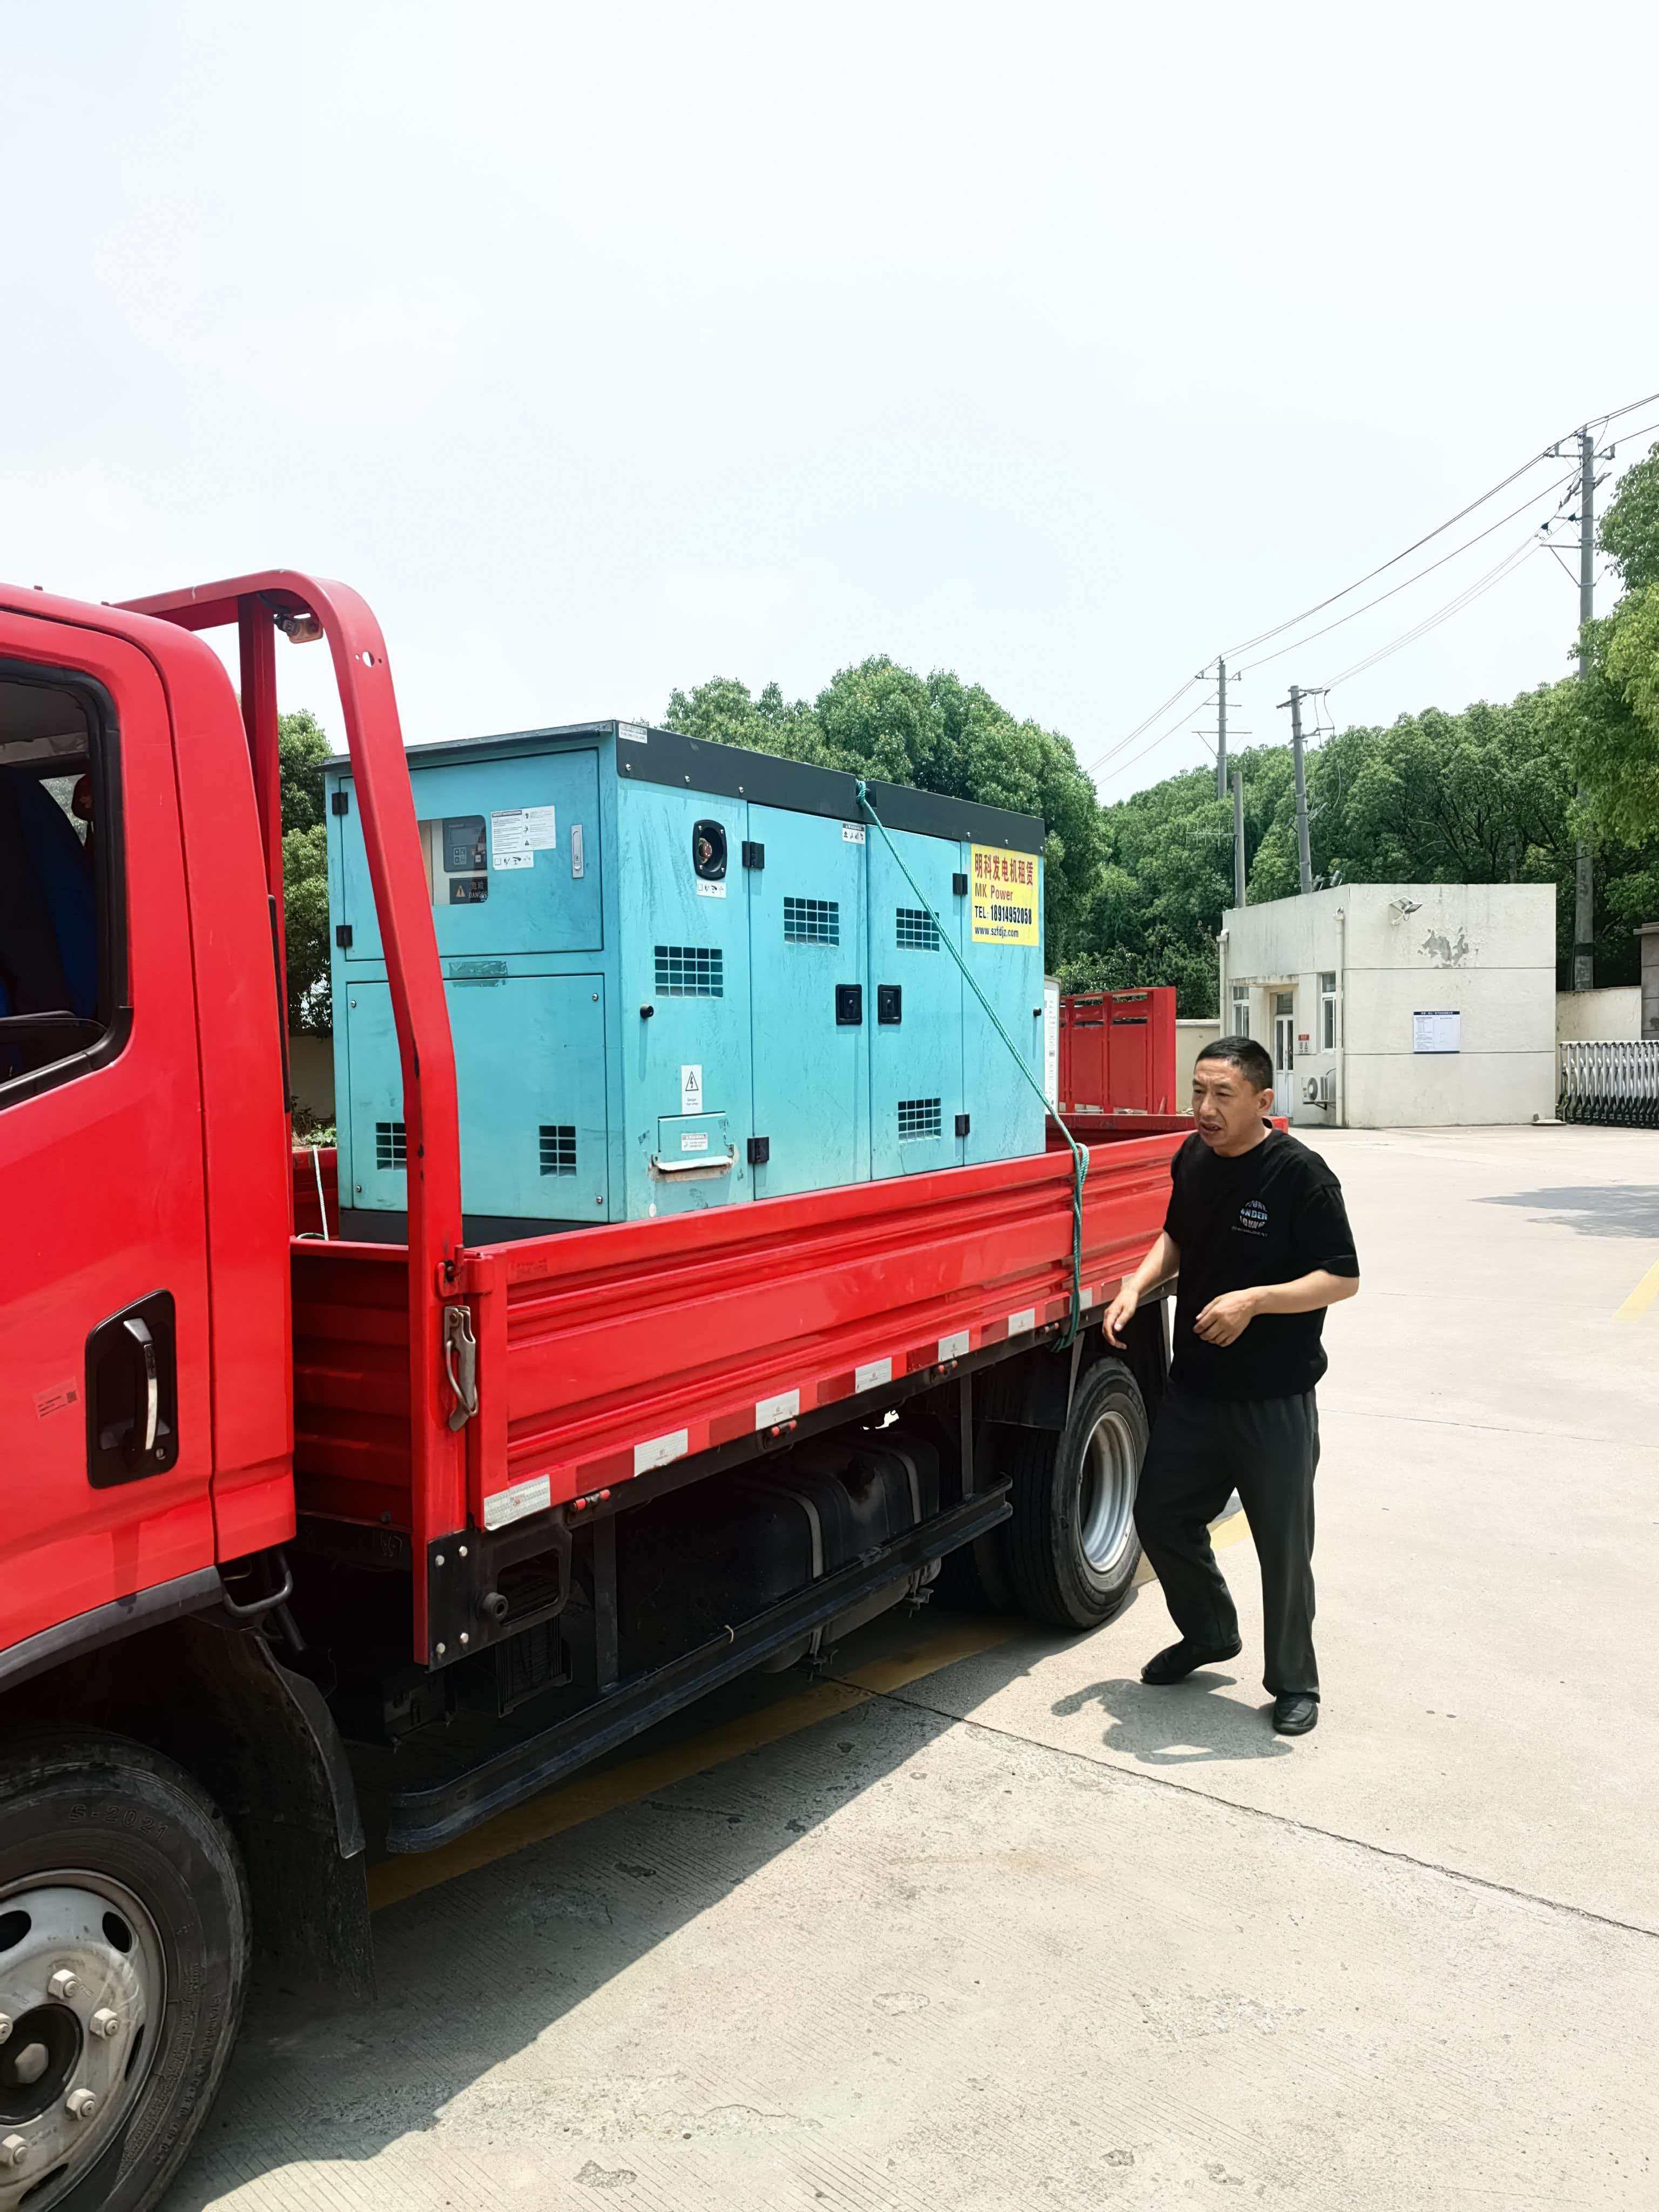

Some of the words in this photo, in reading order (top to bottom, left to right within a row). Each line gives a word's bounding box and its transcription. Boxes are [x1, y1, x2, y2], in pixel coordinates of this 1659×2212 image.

[975, 853, 1033, 886] 明科发电机租赁
[975, 883, 987, 898] MK
[990, 885, 1013, 901] Power
[990, 905, 1031, 925] 18914952058
